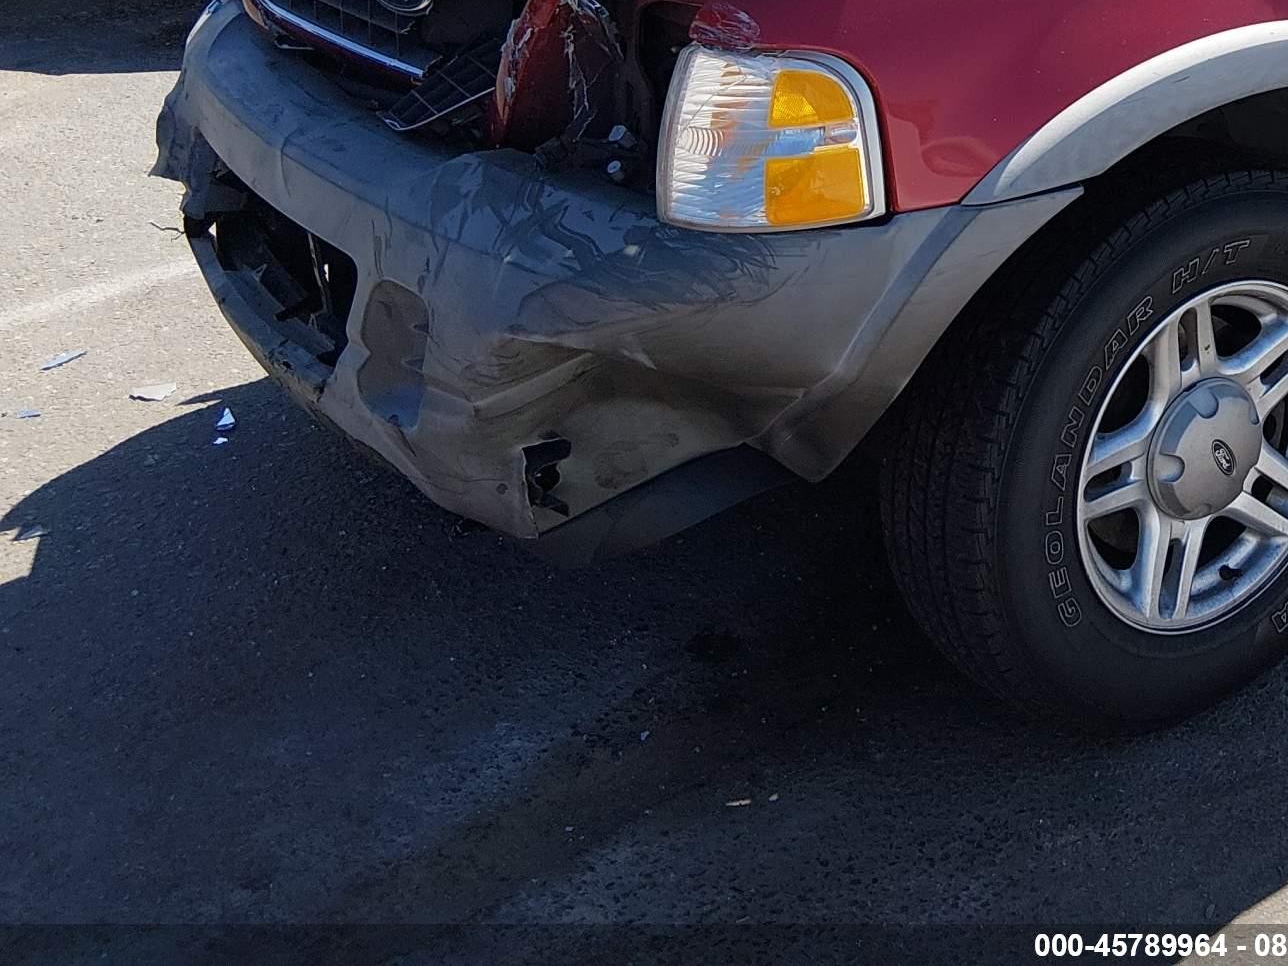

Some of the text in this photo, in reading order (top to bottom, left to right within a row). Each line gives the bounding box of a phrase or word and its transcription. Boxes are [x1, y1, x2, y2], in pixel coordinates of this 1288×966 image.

[1045, 239, 1251, 628] GEOLANDAR H/T
[1214, 447, 1231, 470] Ford
